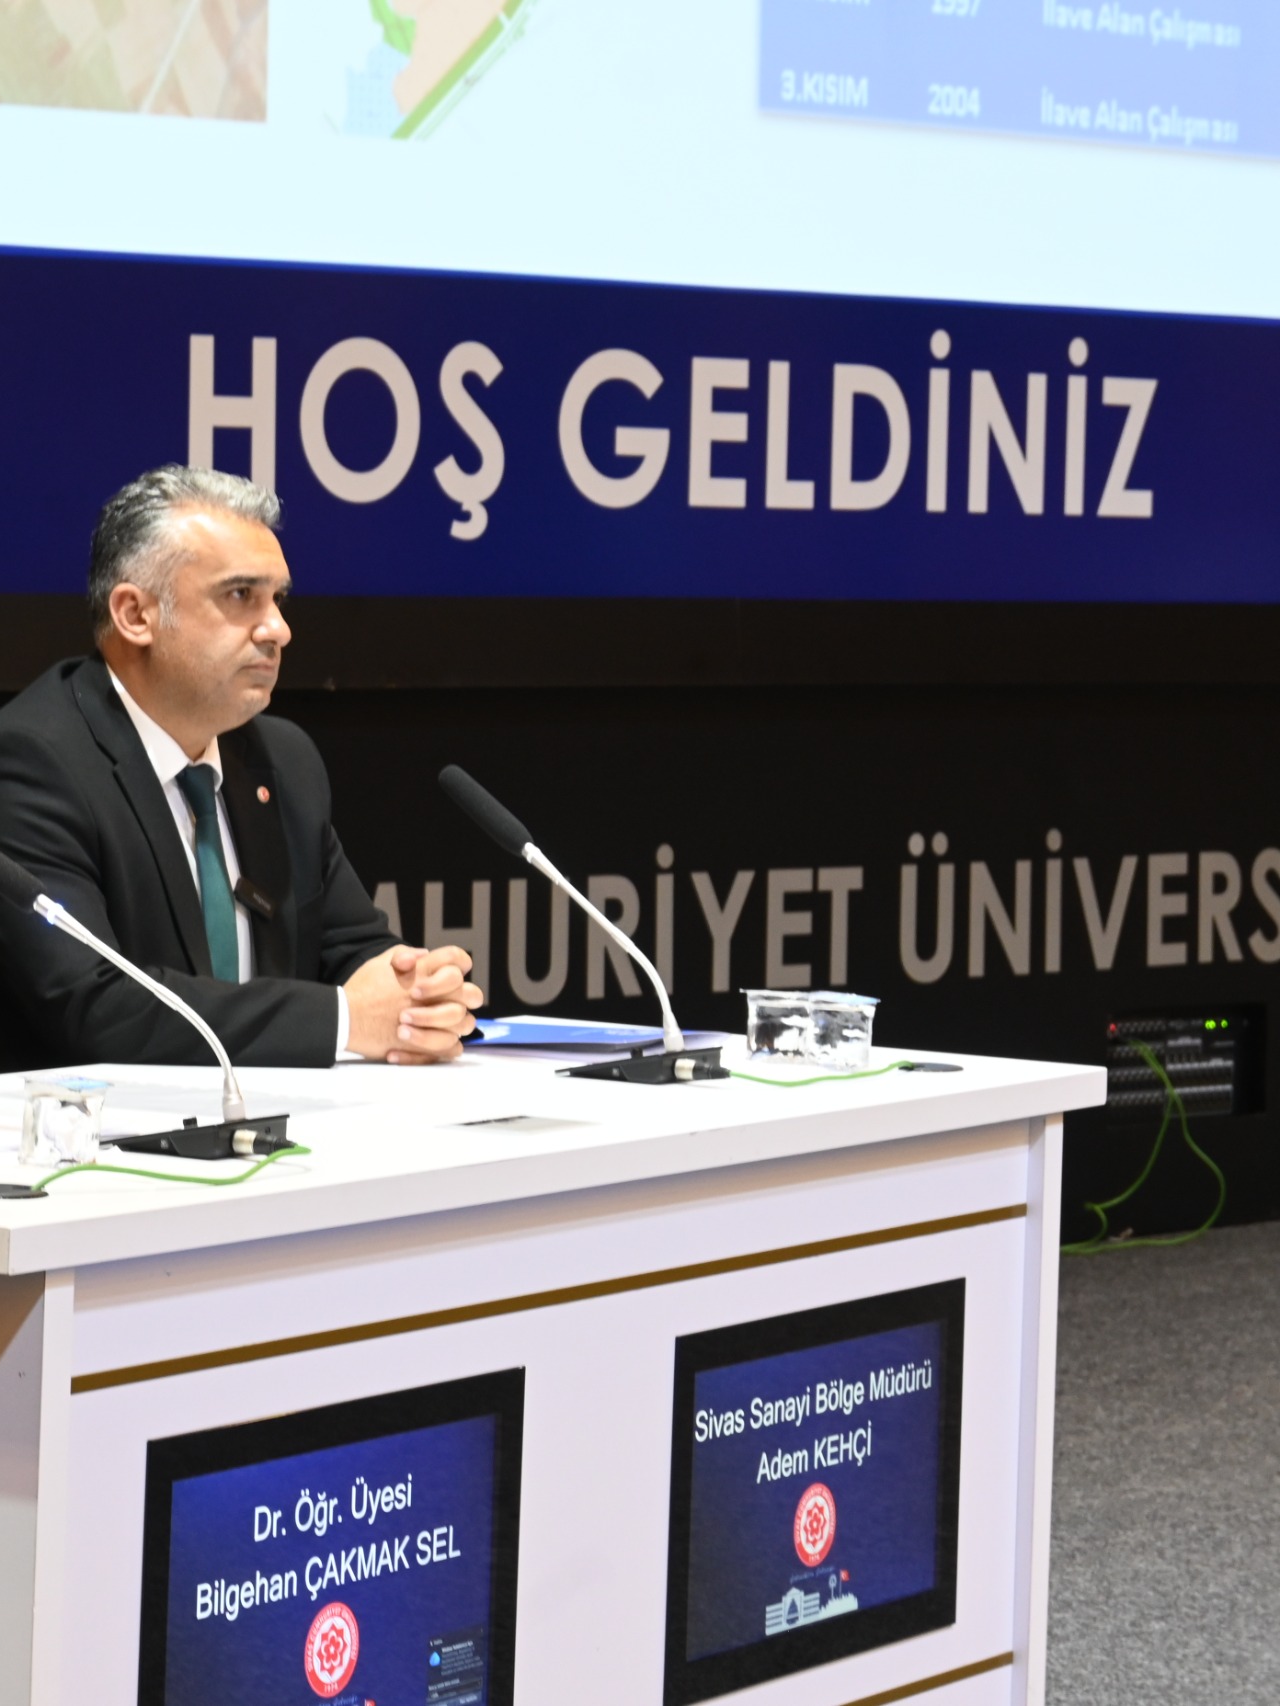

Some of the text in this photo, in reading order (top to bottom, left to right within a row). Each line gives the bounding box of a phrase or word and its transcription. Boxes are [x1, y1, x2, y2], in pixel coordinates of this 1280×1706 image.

[1097, 2, 1145, 36] Alan
[1150, 8, 1241, 50] Çalışması
[780, 68, 1239, 146] 3.KISIM 2004 İlave Alan Çalışması
[188, 330, 1158, 541] HOŞ GELDİNİZ
[695, 1360, 933, 1442] Sivas Sanayi Bölge Müdürü
[756, 1421, 872, 1484] Adem KEHÇİ
[254, 1474, 412, 1542] Dr. Öğr. Üyesi
[196, 1525, 462, 1622] Bilgehan ÇAKMAK SEL
